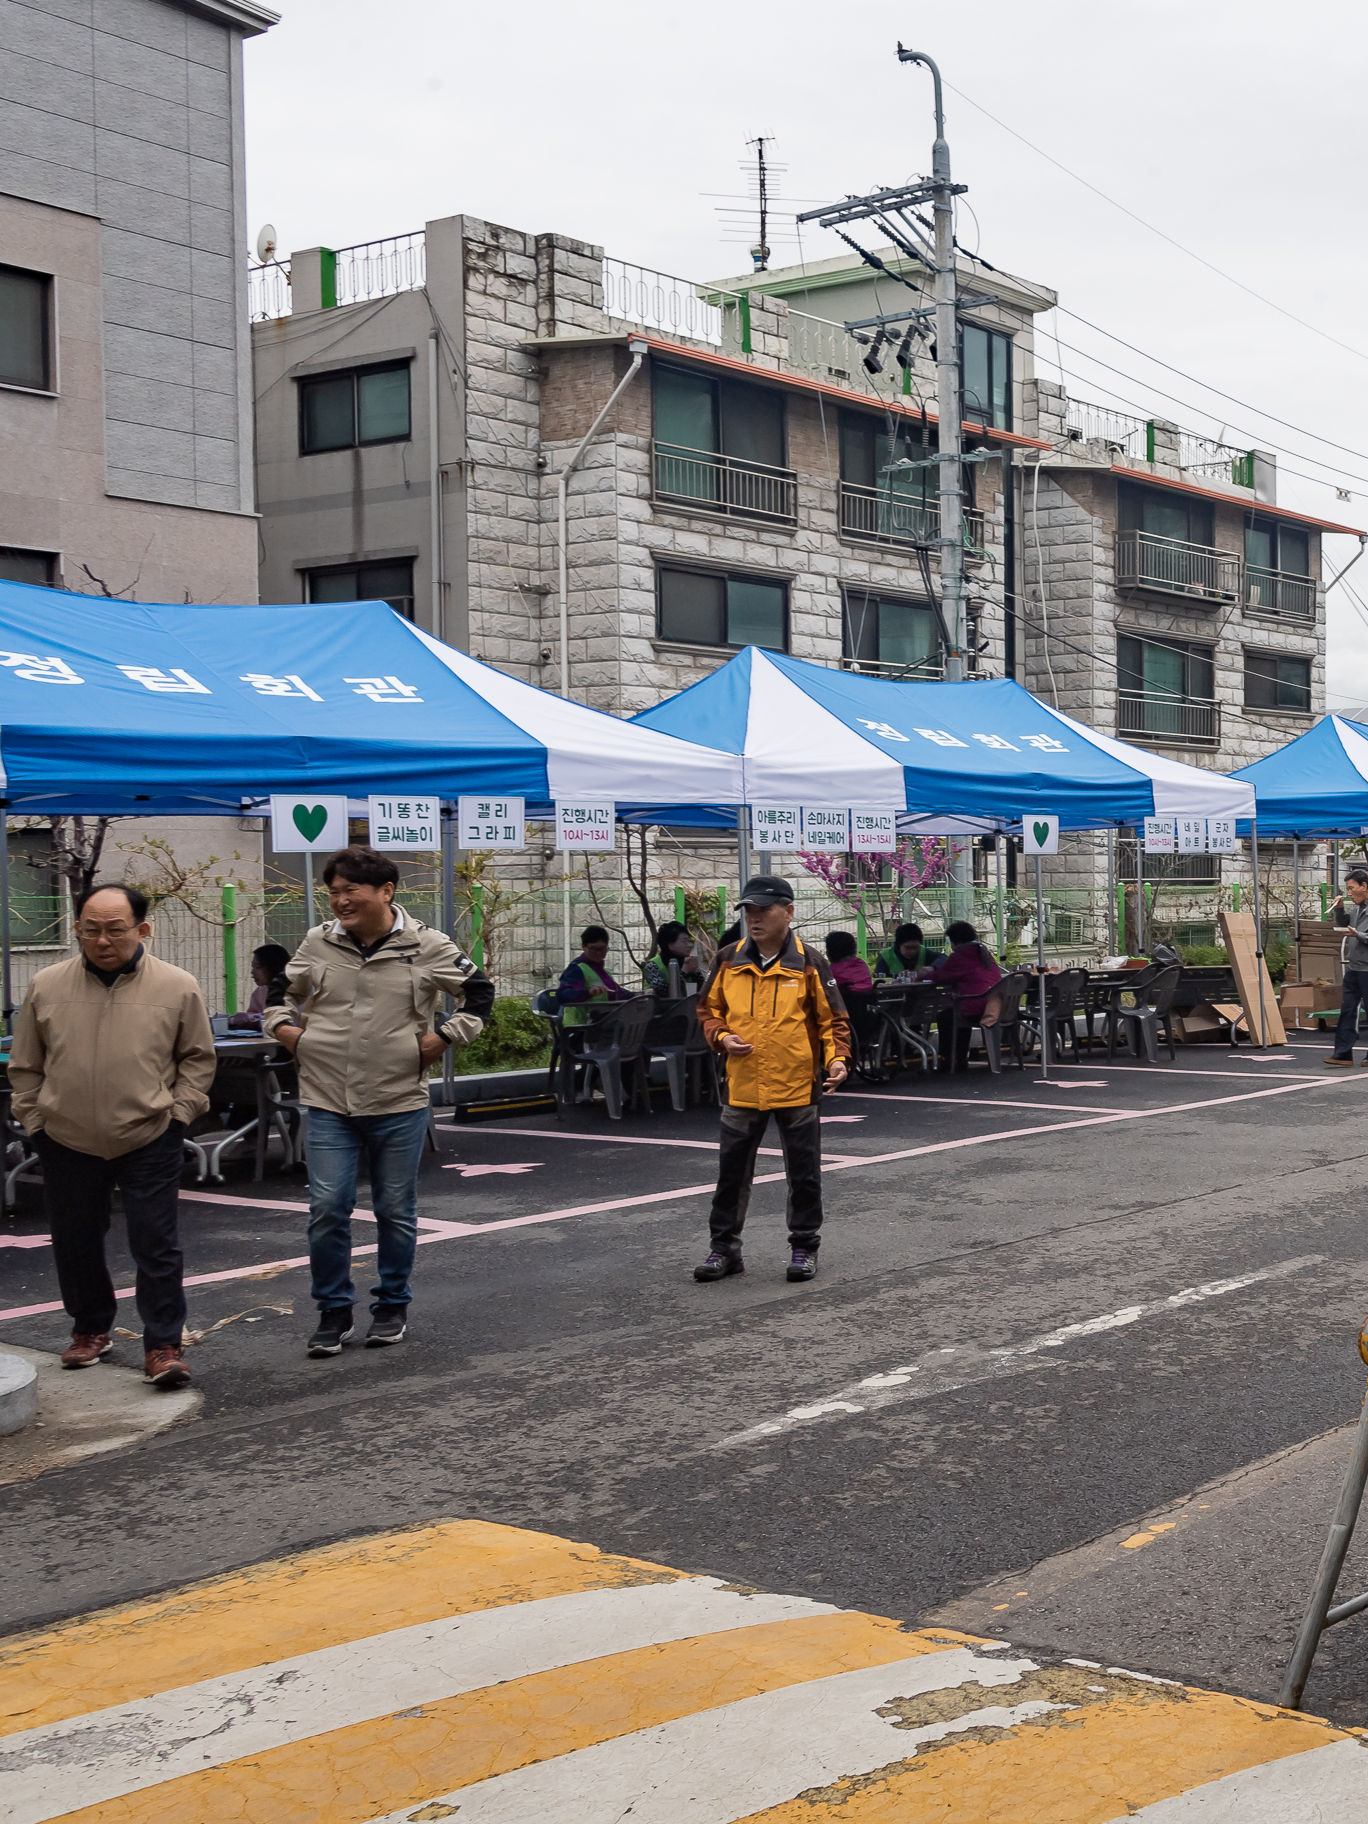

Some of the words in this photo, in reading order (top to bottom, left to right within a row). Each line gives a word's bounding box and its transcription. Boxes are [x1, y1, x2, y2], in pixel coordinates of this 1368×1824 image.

[0, 650, 425, 703] 정립회관
[855, 717, 1071, 753] 정립회관
[477, 803, 508, 819] 캘리
[561, 808, 610, 824] 진행시간
[757, 810, 796, 825] 아름주리
[807, 811, 845, 826] 손마사지
[856, 816, 892, 830] 진행시간
[1147, 822, 1172, 834] 진행시간
[376, 826, 433, 843] 글씨놀이
[467, 825, 516, 842] 그라피
[562, 829, 609, 841] 10시~13시
[759, 830, 795, 844] 봉사단
[807, 831, 845, 845] 네일케어
[857, 834, 892, 844] 13시~15시
